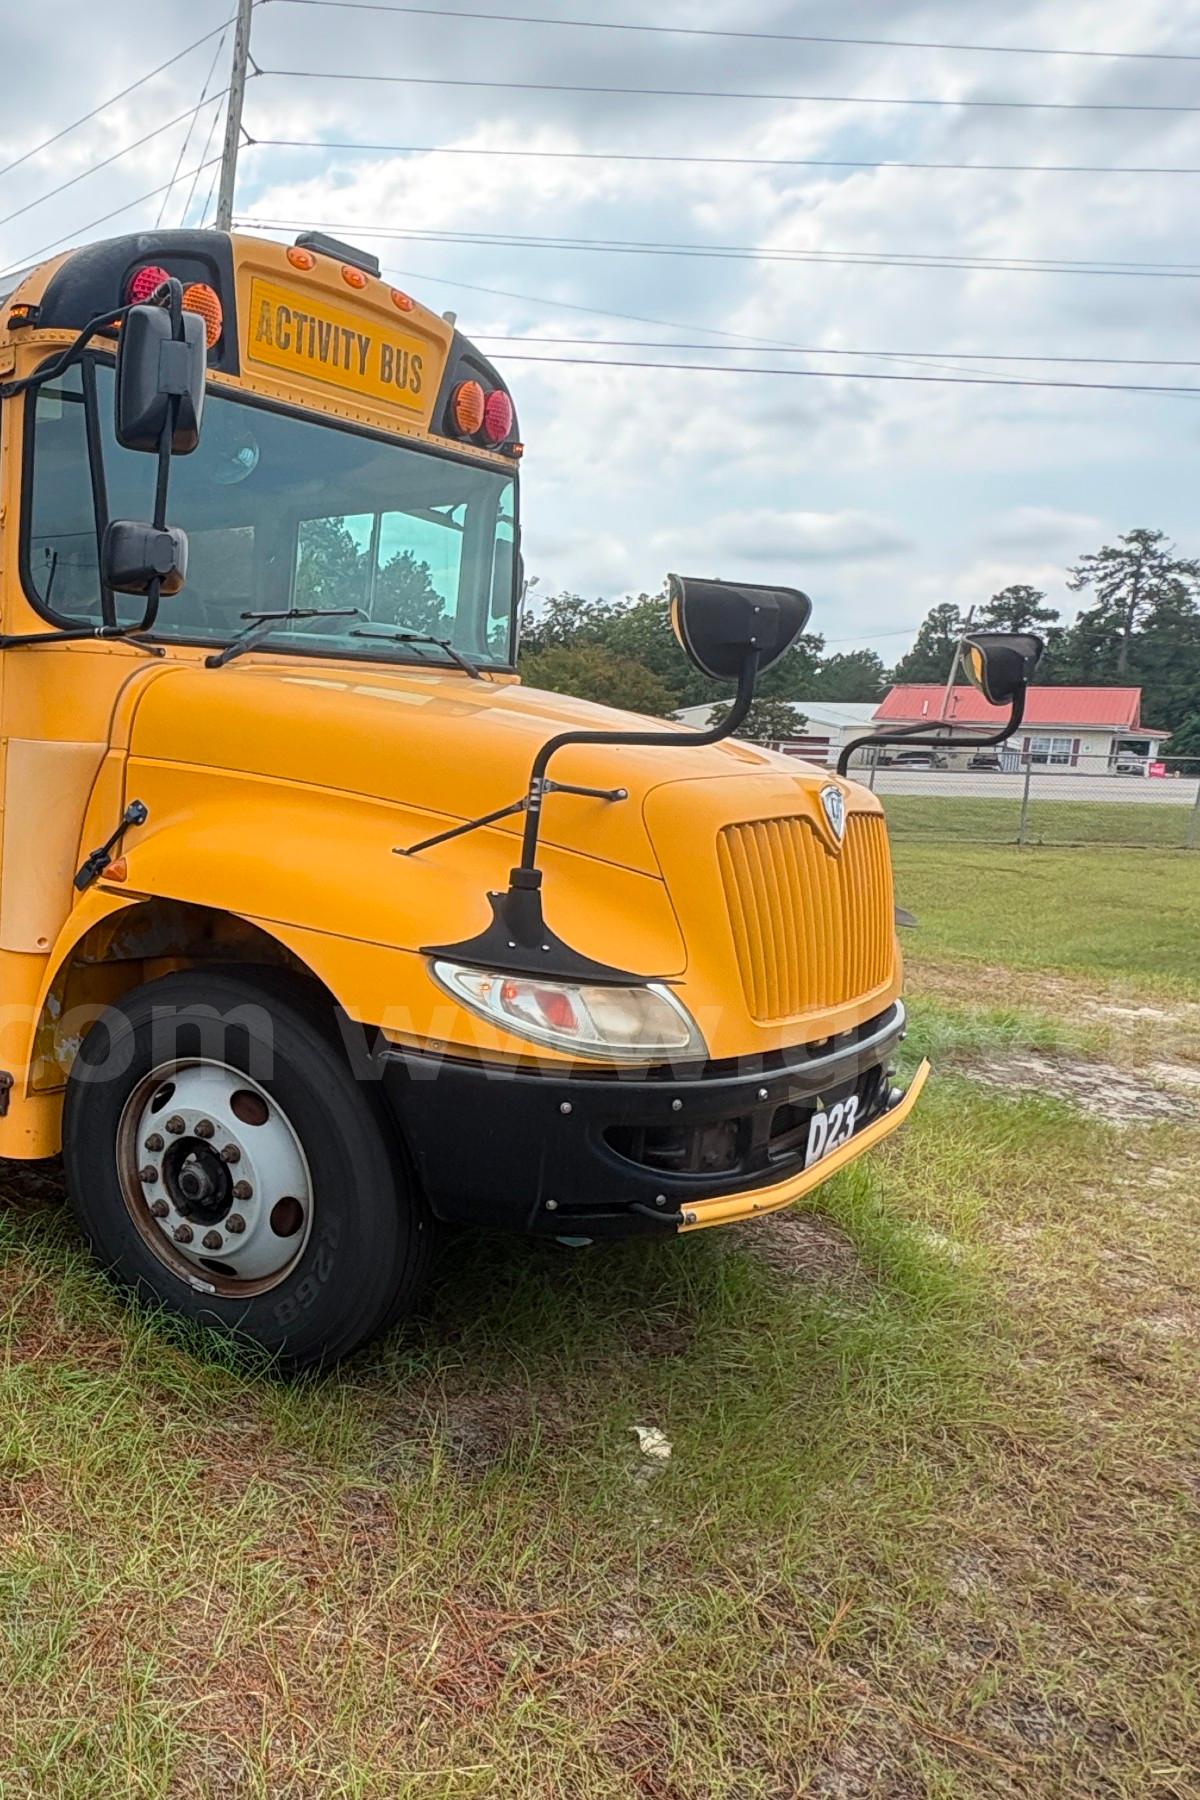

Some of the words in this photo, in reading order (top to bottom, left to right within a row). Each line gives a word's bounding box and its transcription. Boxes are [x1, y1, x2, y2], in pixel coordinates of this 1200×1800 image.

[255, 299, 371, 376] ACTIVITY
[380, 343, 423, 394] BUS
[805, 1095, 859, 1169] D23
